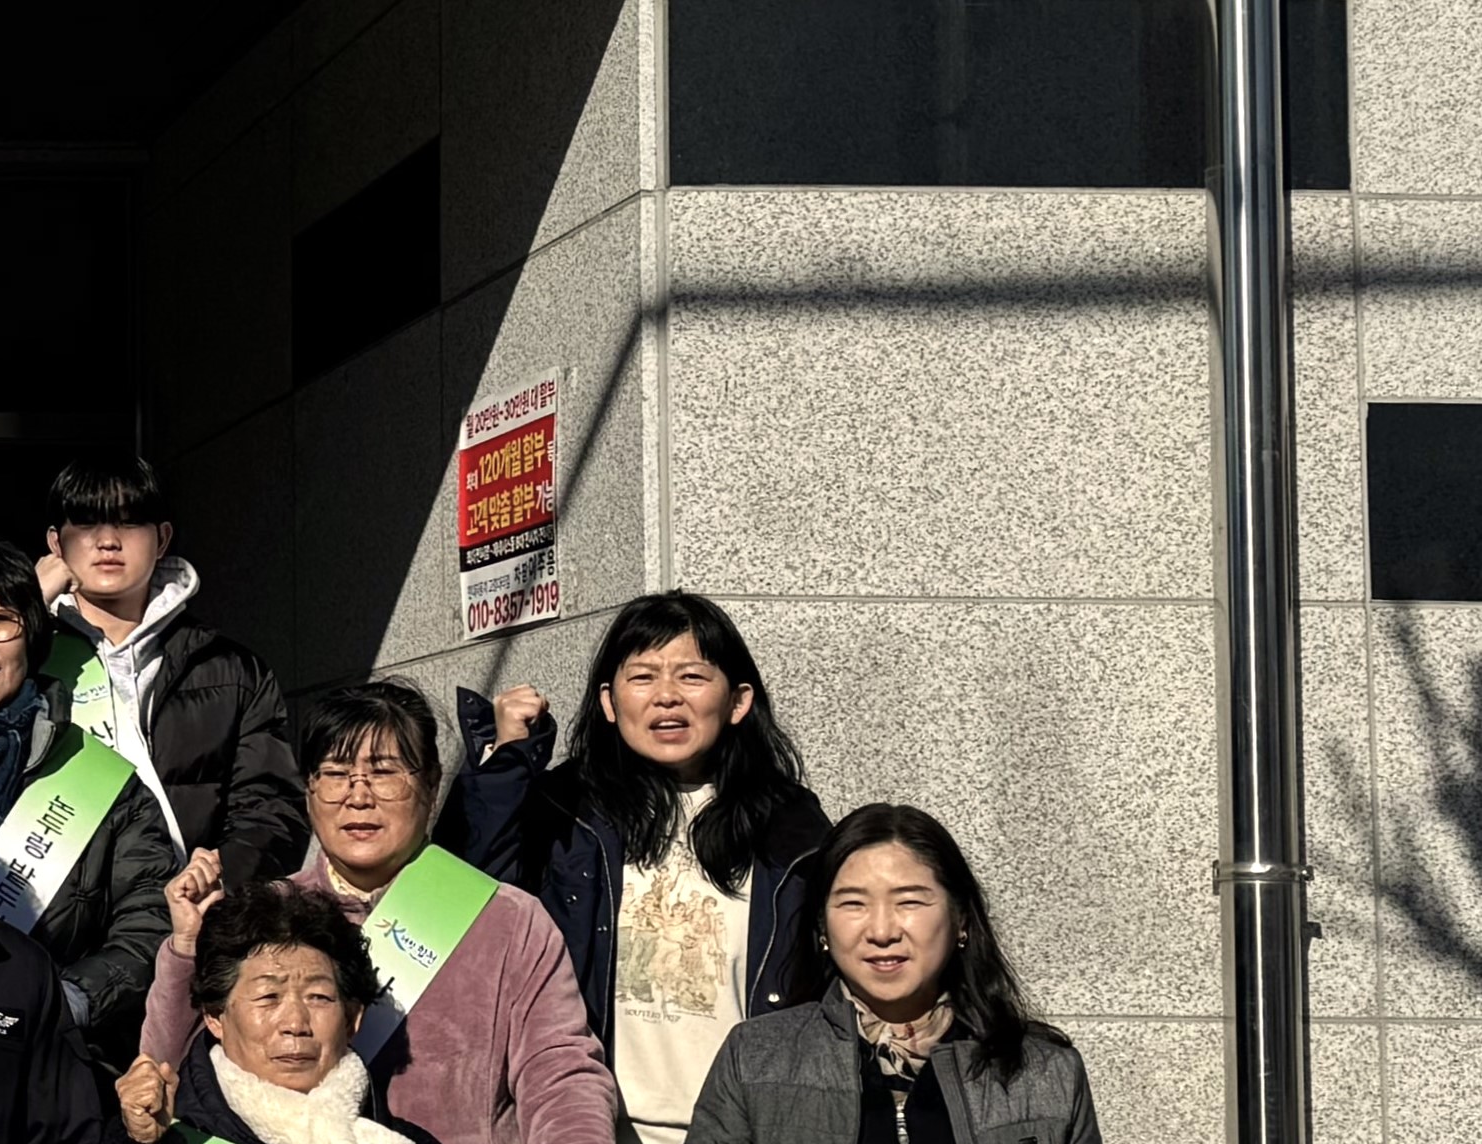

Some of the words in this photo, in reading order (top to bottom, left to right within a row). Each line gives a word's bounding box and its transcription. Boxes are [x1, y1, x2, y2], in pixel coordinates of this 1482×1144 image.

[479, 437, 521, 485] 120개월
[523, 429, 545, 473] 할부
[467, 497, 488, 536] 고객
[489, 491, 510, 532] 맞춤
[512, 481, 535, 525] 할부
[536, 480, 555, 515] 가능
[468, 580, 559, 633] 010-8357-1919
[25, 796, 78, 858] 논두렁
